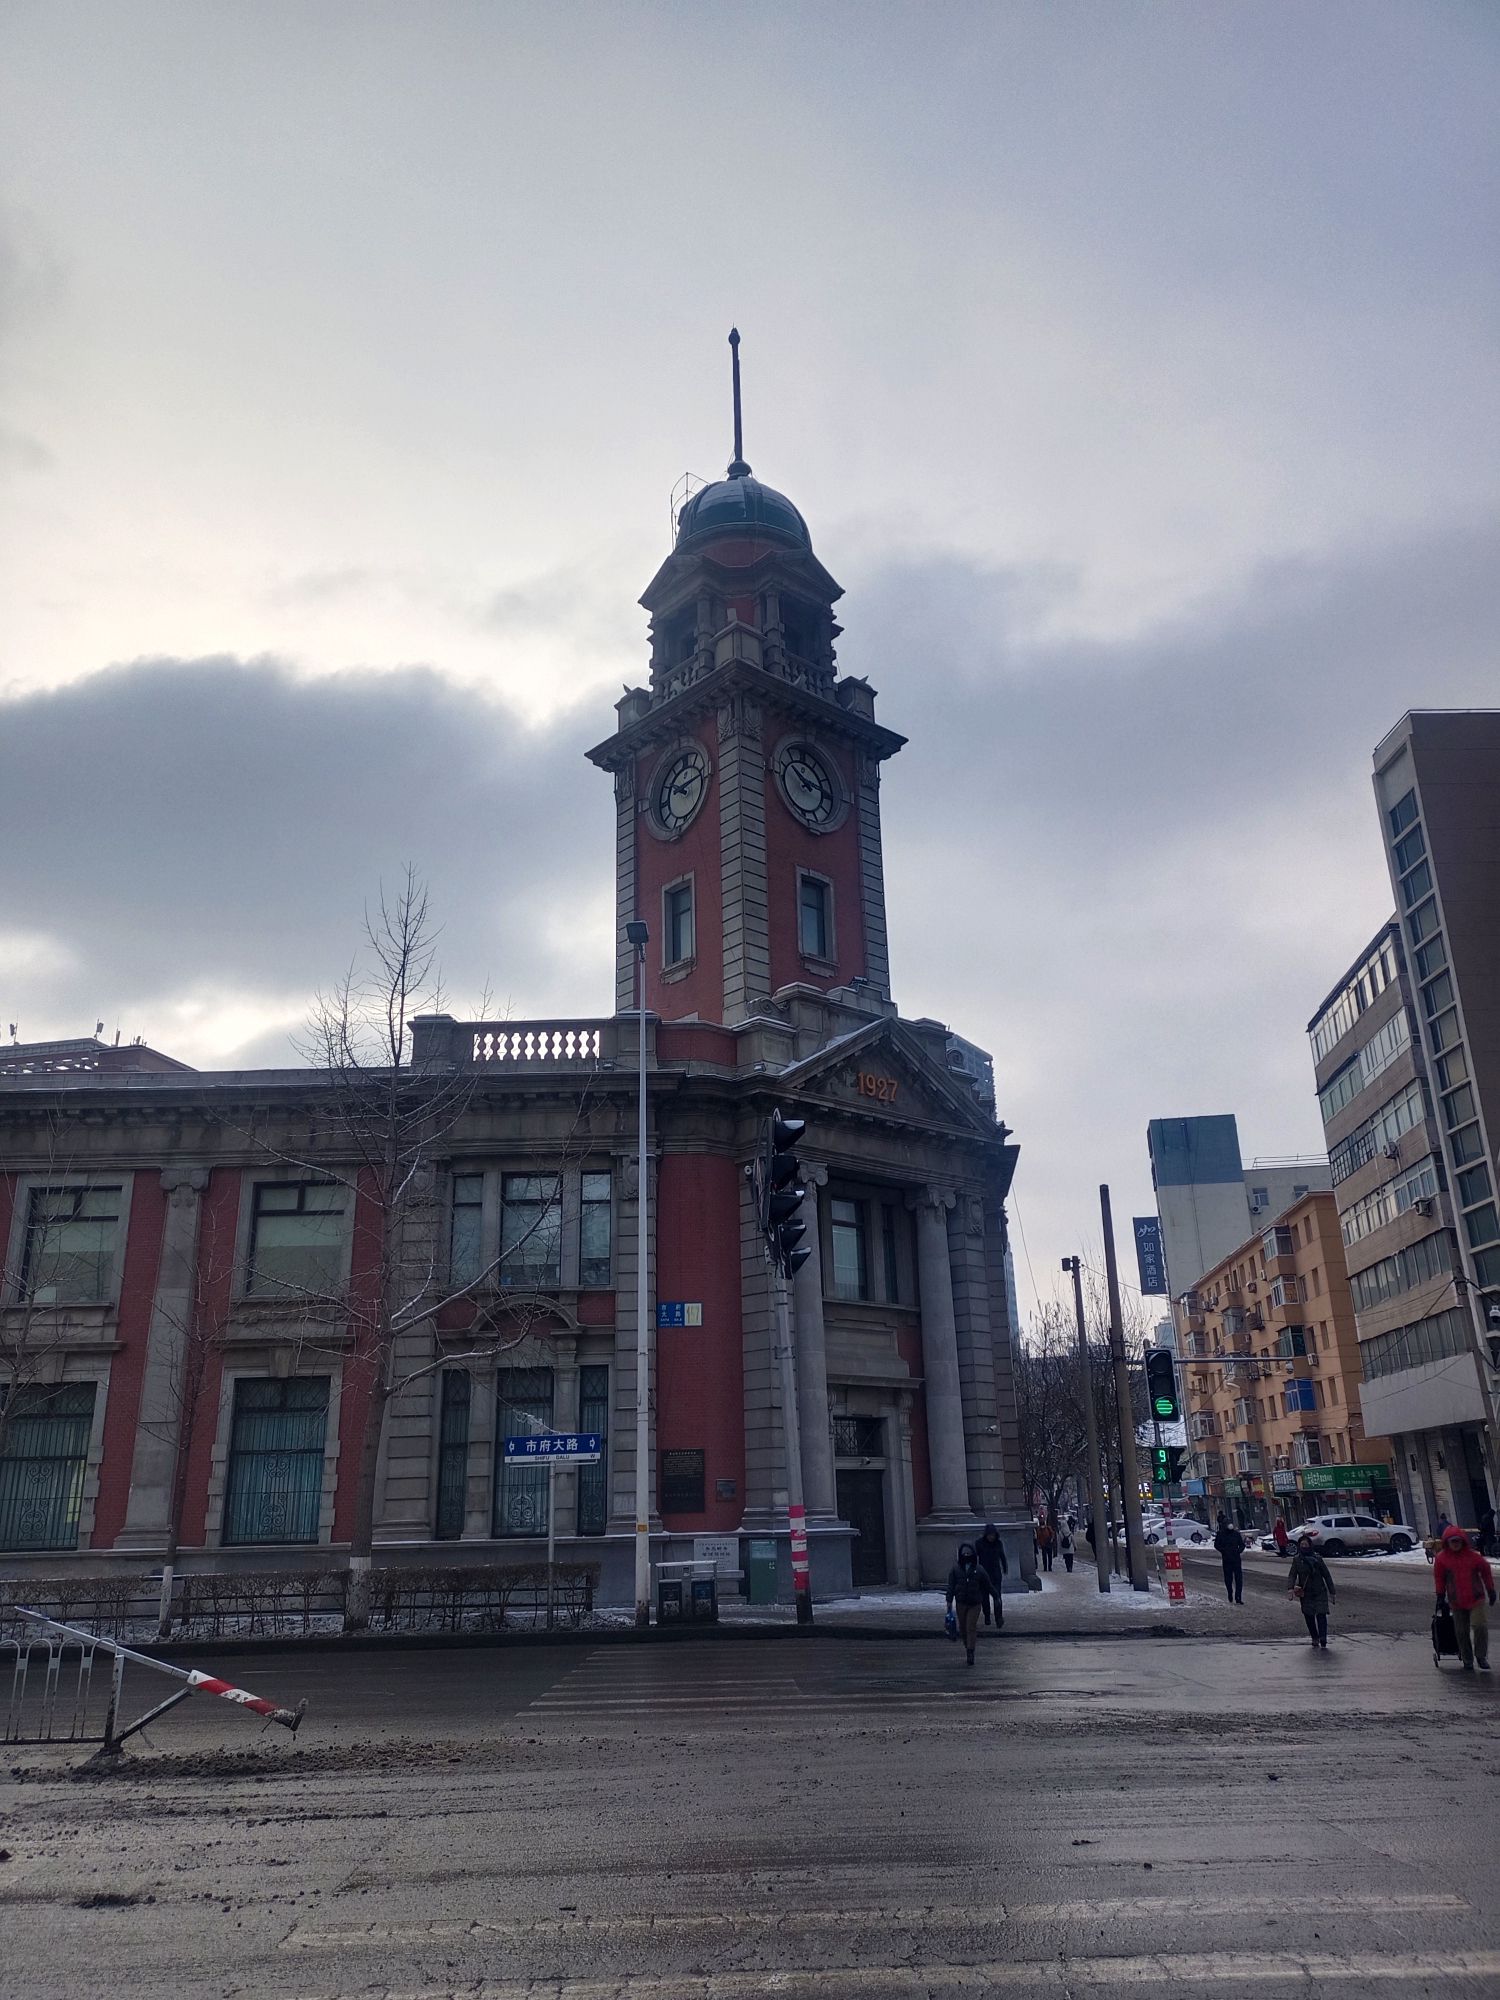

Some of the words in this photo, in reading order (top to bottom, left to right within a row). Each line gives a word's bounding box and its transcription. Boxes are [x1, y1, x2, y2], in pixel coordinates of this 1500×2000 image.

[858, 1072, 897, 1102] 1927
[1143, 1242, 1157, 1287] 如家酒店
[525, 1438, 579, 1453] 市府大路
[1159, 1449, 1167, 1462] 9
